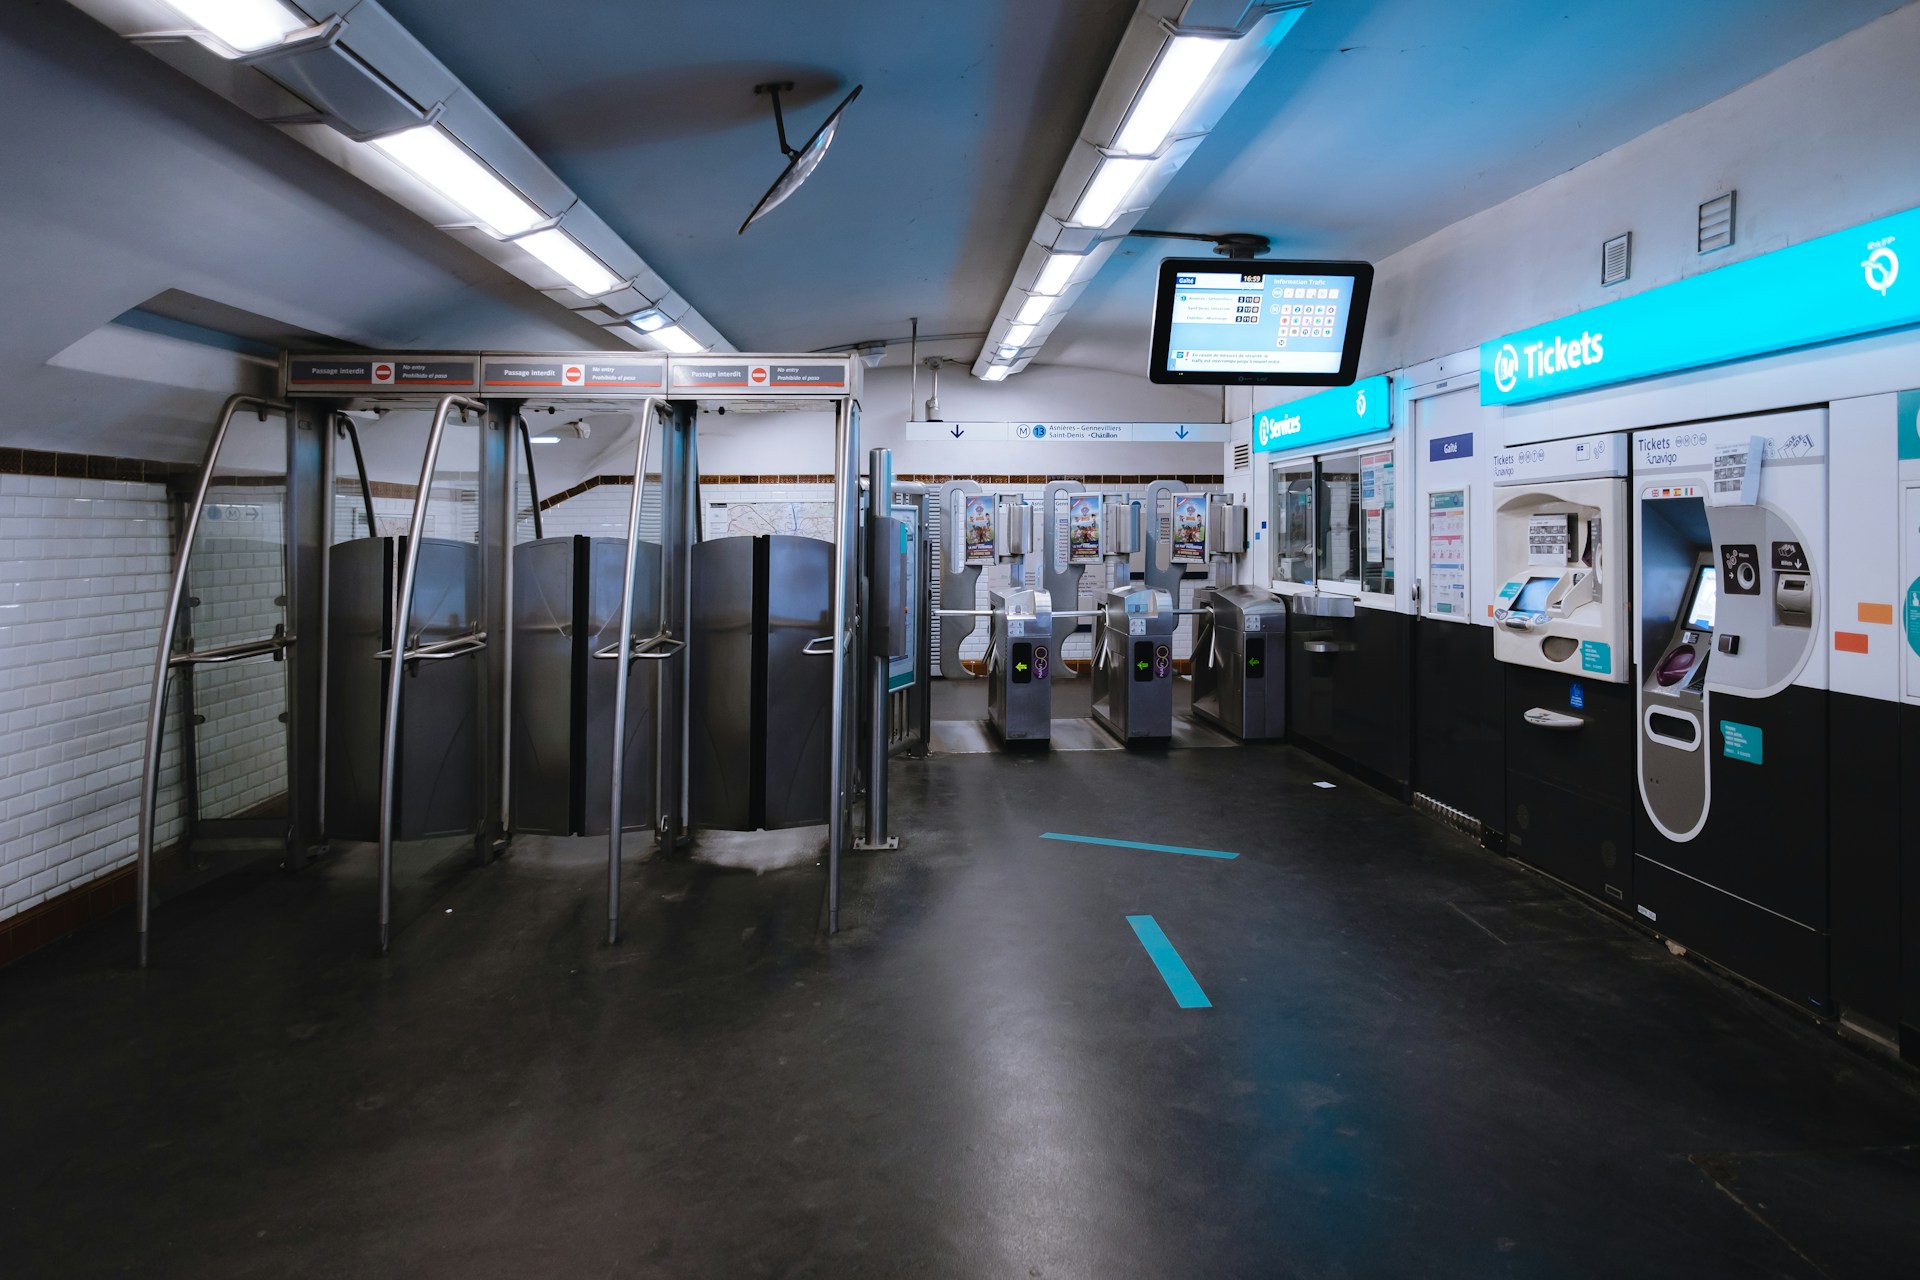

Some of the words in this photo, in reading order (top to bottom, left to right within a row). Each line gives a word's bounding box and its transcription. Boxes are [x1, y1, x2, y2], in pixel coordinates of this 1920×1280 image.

[1866, 236, 1896, 250] RATP
[1524, 331, 1604, 378] Tickets
[312, 367, 338, 375] Passage
[1034, 427, 1044, 436] 13
[1270, 414, 1300, 439] Services
[1444, 442, 1457, 454] Gaîté
[1638, 438, 1670, 451] Tickets
[1494, 455, 1514, 466] Tickets
[1648, 453, 1677, 466] navigo
